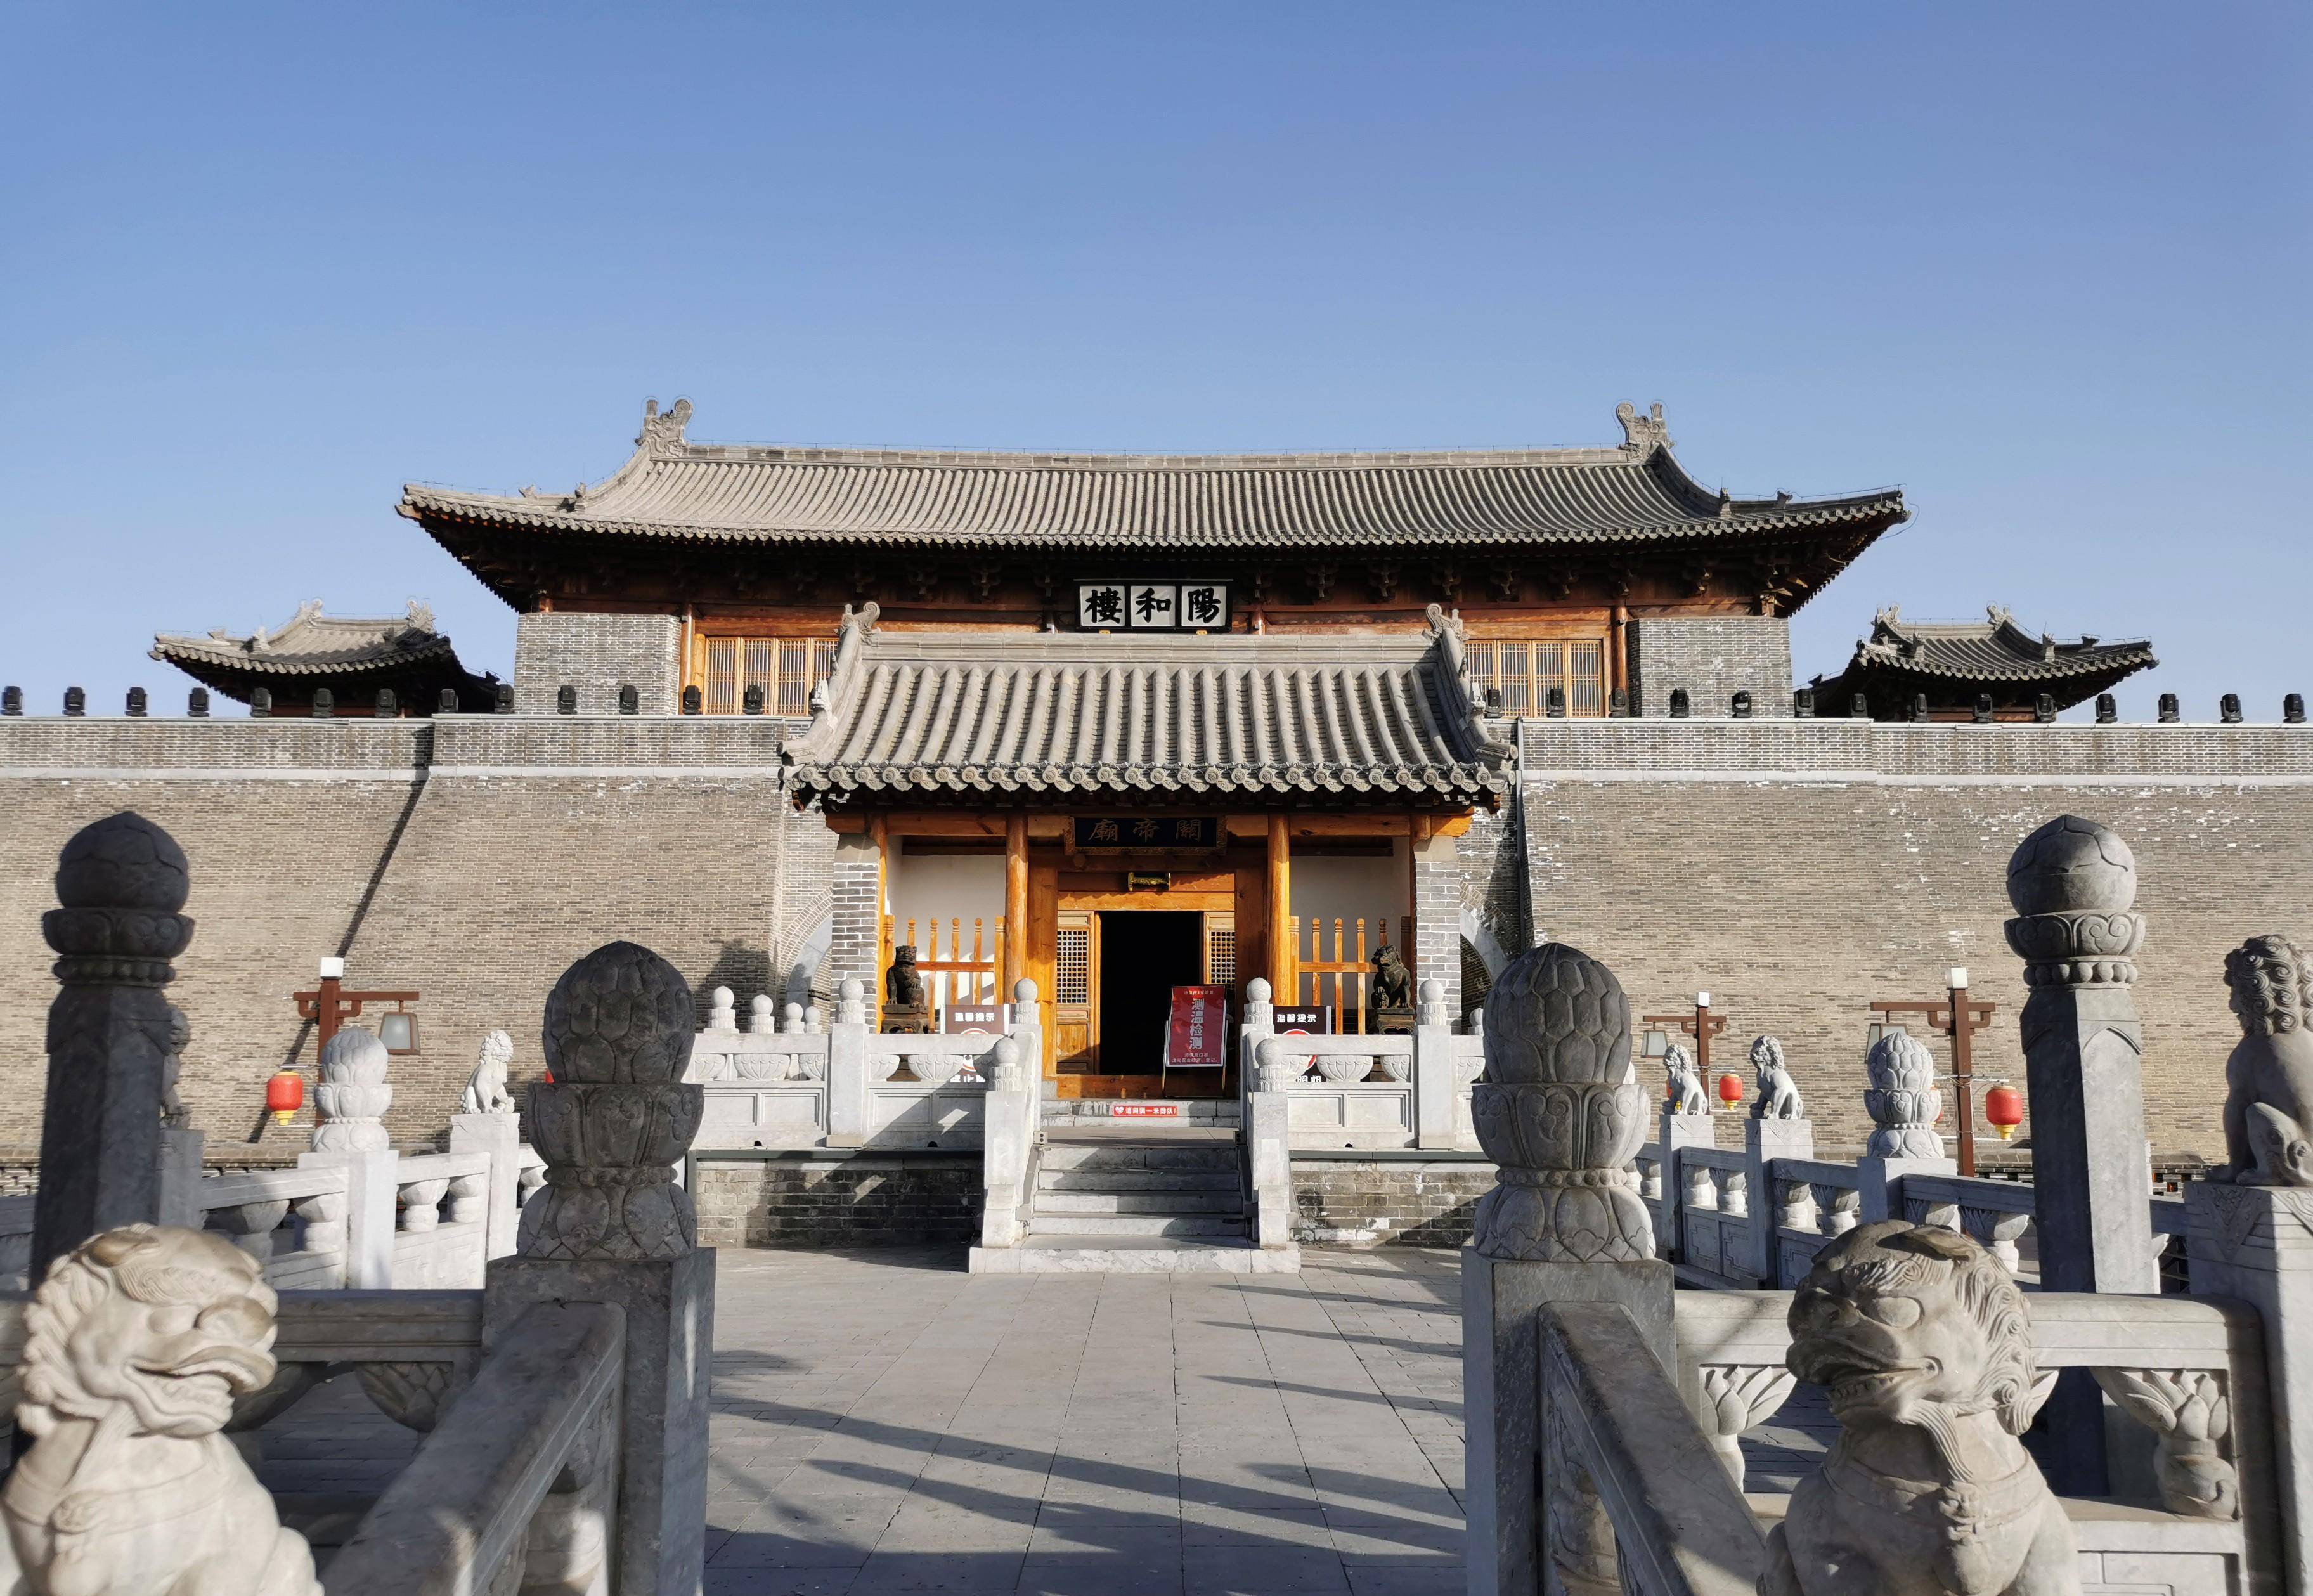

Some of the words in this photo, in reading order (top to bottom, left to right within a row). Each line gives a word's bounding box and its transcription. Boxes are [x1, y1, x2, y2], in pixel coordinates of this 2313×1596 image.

[1189, 998, 1204, 1049] 测温检测
[1276, 1014, 1317, 1023] 温馨提示
